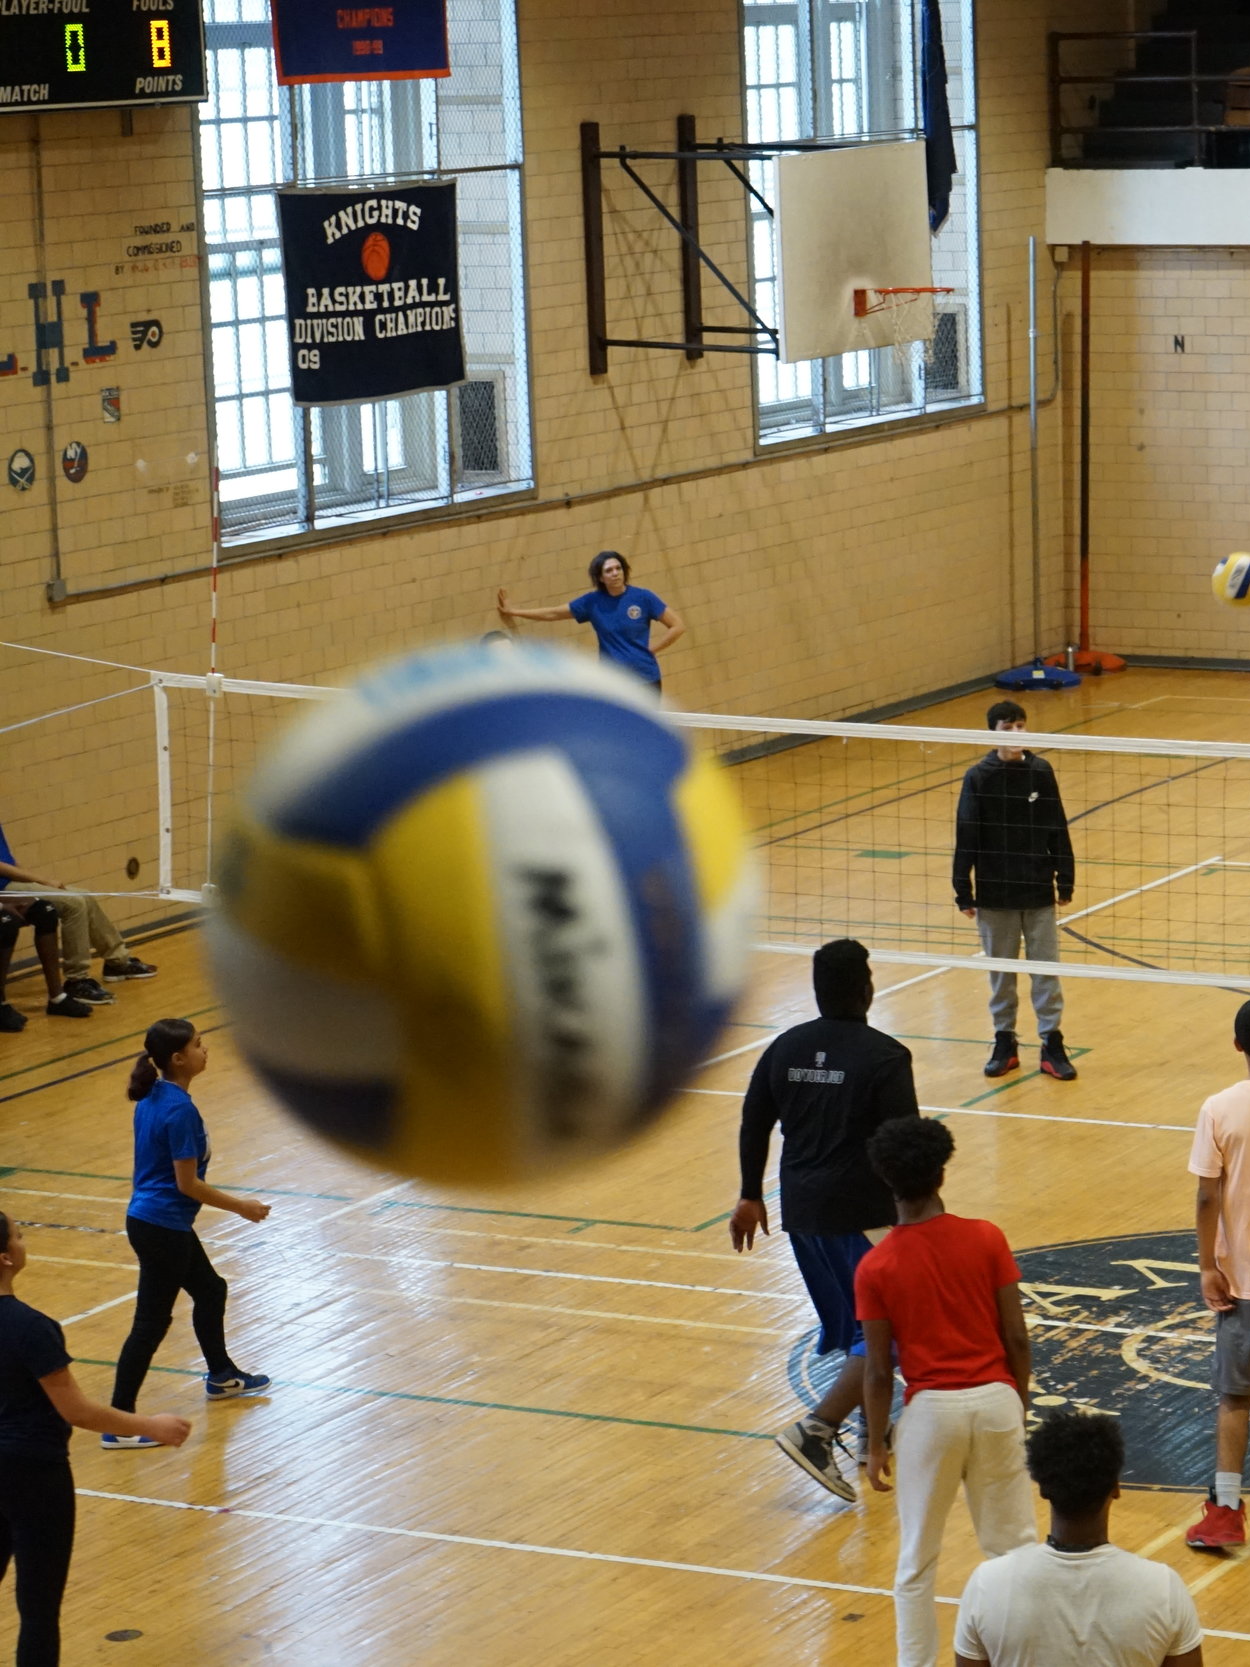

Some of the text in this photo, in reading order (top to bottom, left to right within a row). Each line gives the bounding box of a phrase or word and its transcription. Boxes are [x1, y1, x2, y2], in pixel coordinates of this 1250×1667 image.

[0, 0, 90, 15] LAYER-FOUL
[132, 0, 174, 11] FOULS
[65, 24, 86, 72] 0
[150, 20, 172, 67] 8
[0, 83, 49, 103] MATCH
[135, 74, 183, 94] POINTS
[323, 199, 422, 245] KNIGHTS
[306, 278, 450, 313] BASKETBALL
[294, 316, 365, 343] DIVISION
[1174, 335, 1185, 353] N
[298, 349, 320, 370] 09
